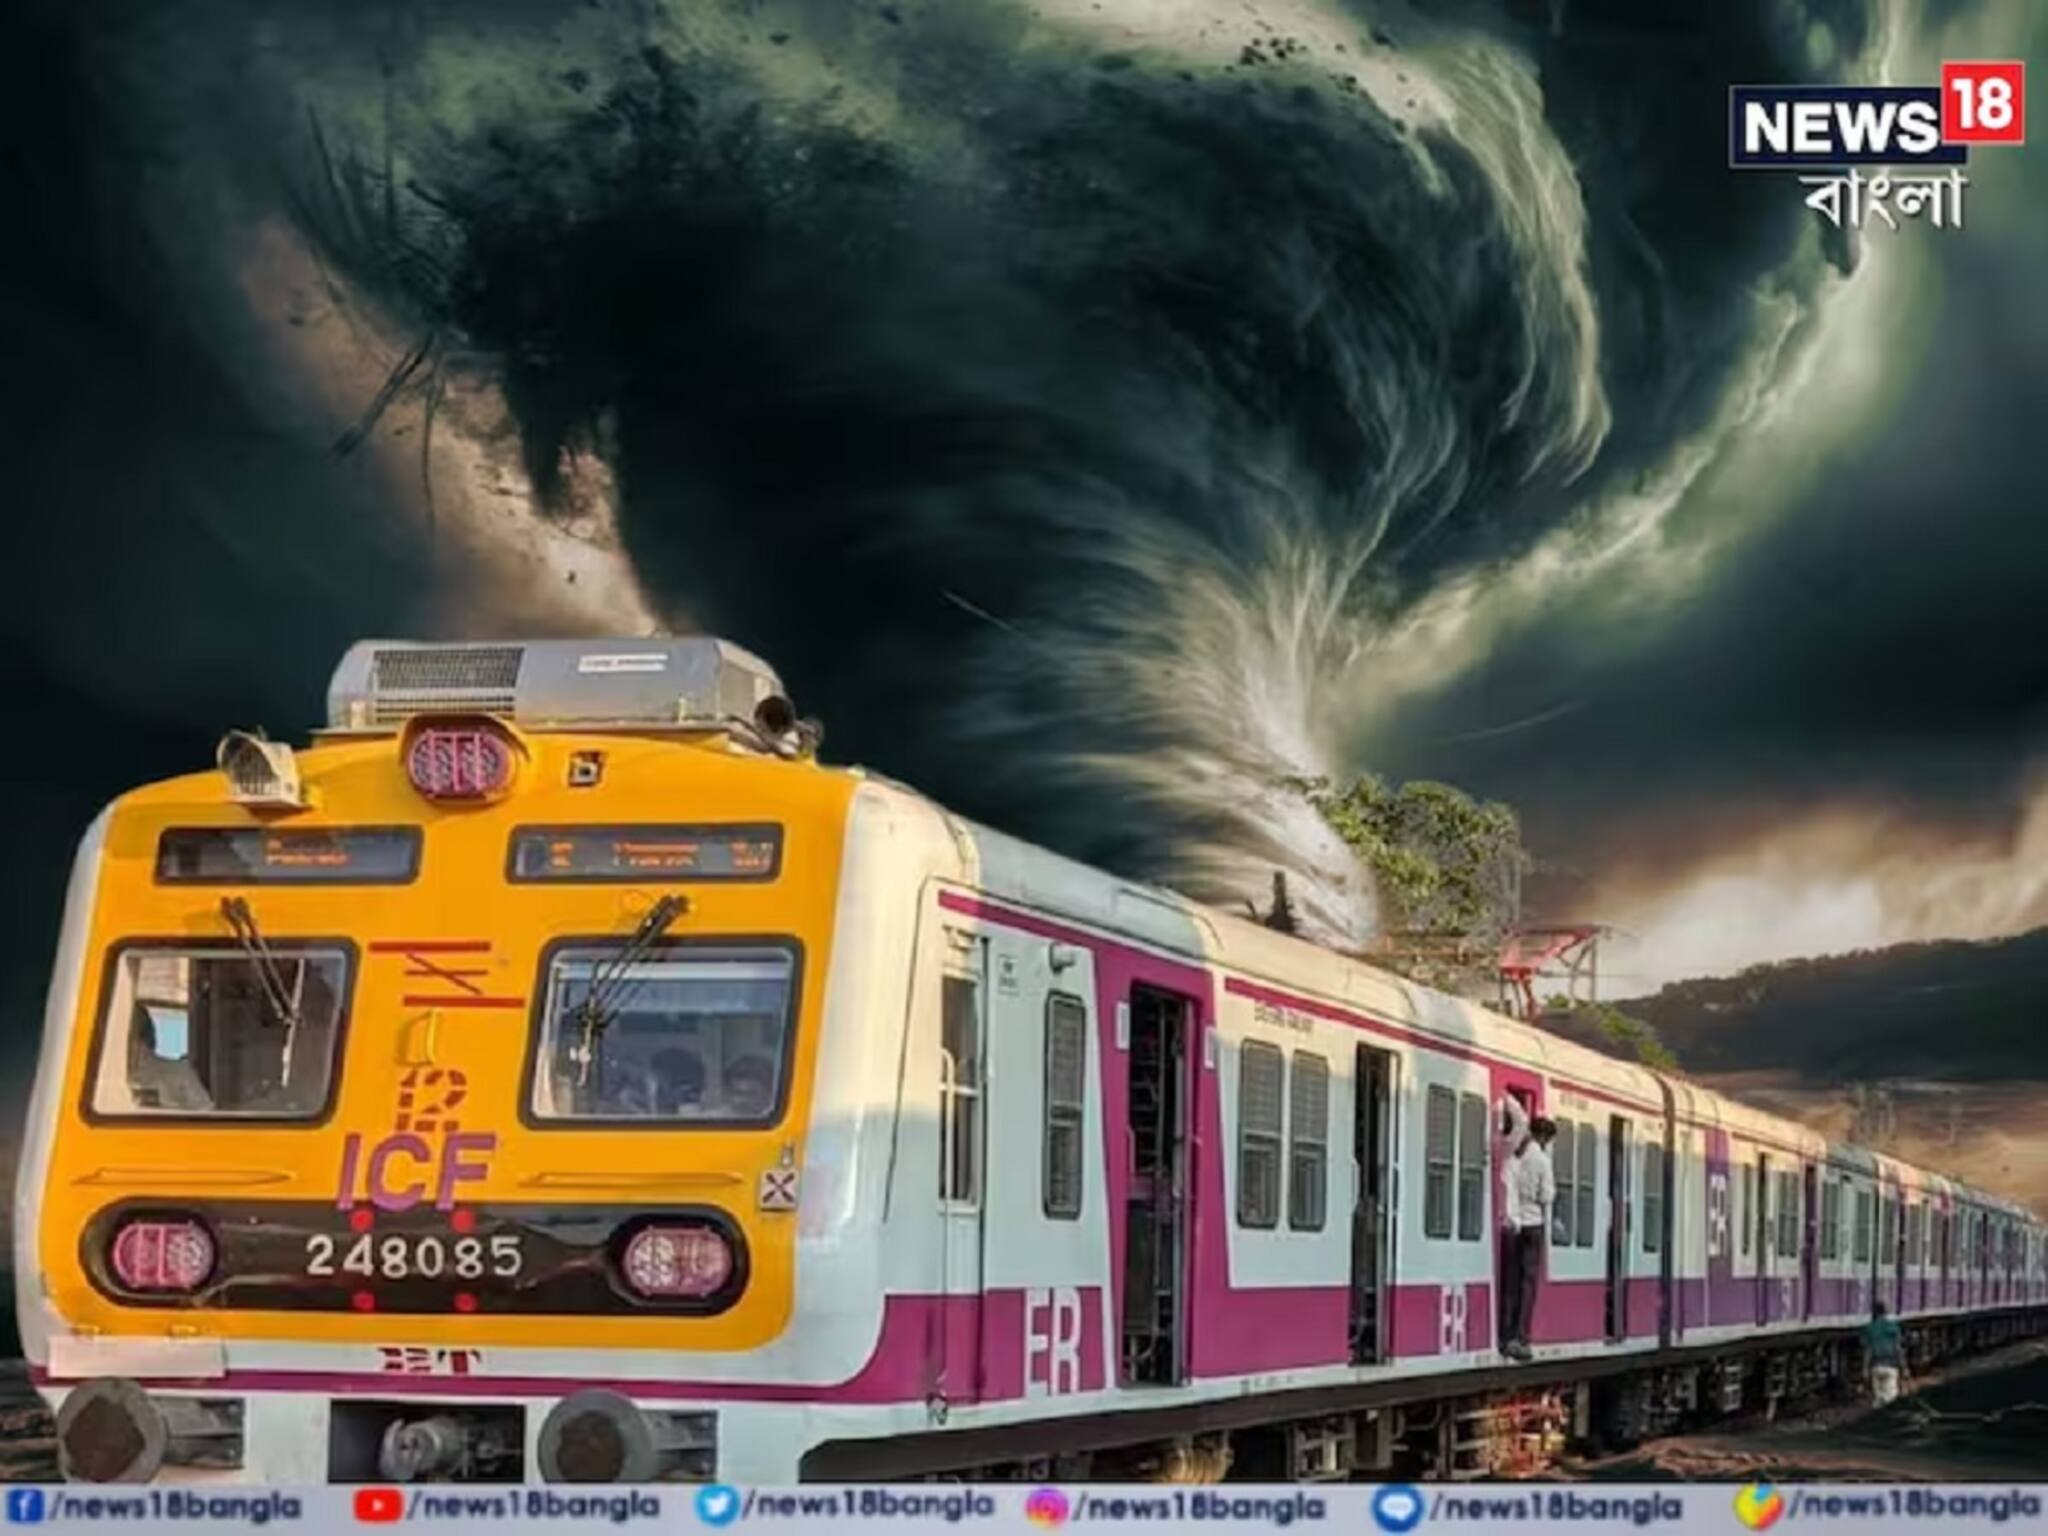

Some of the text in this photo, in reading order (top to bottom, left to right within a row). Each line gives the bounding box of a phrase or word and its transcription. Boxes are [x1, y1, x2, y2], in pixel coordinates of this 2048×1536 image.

[337, 1132, 497, 1212] ICF
[305, 1234, 523, 1280] 248085
[1025, 1287, 1082, 1396] ER
[1440, 1285, 1467, 1356] ER
